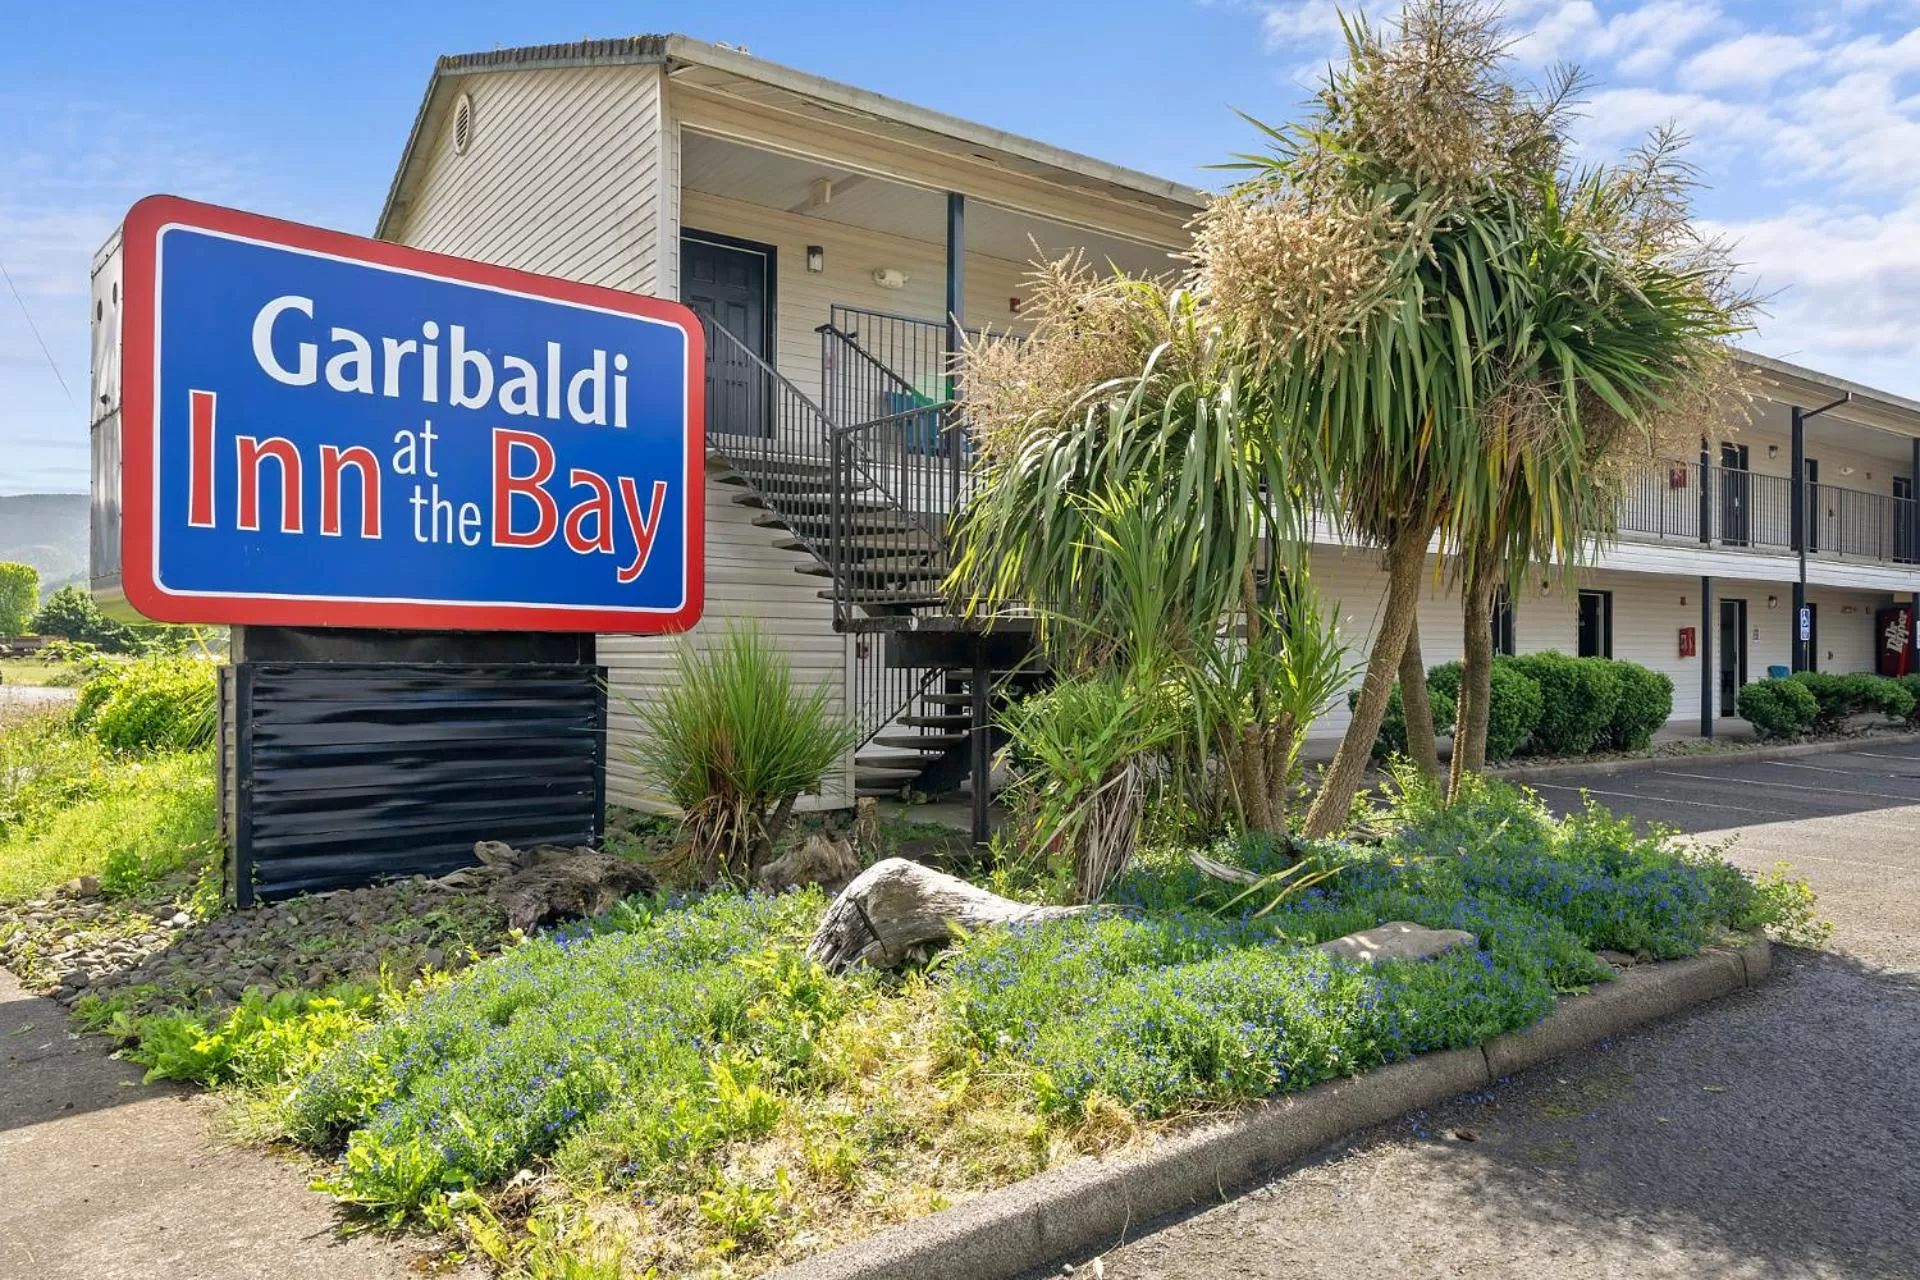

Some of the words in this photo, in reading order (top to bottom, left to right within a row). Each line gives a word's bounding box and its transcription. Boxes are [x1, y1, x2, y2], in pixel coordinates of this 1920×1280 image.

[251, 295, 629, 429] Garibaldi
[187, 388, 382, 540] Inn
[392, 420, 439, 479] at
[409, 484, 482, 546] the
[491, 426, 668, 584] Bay
